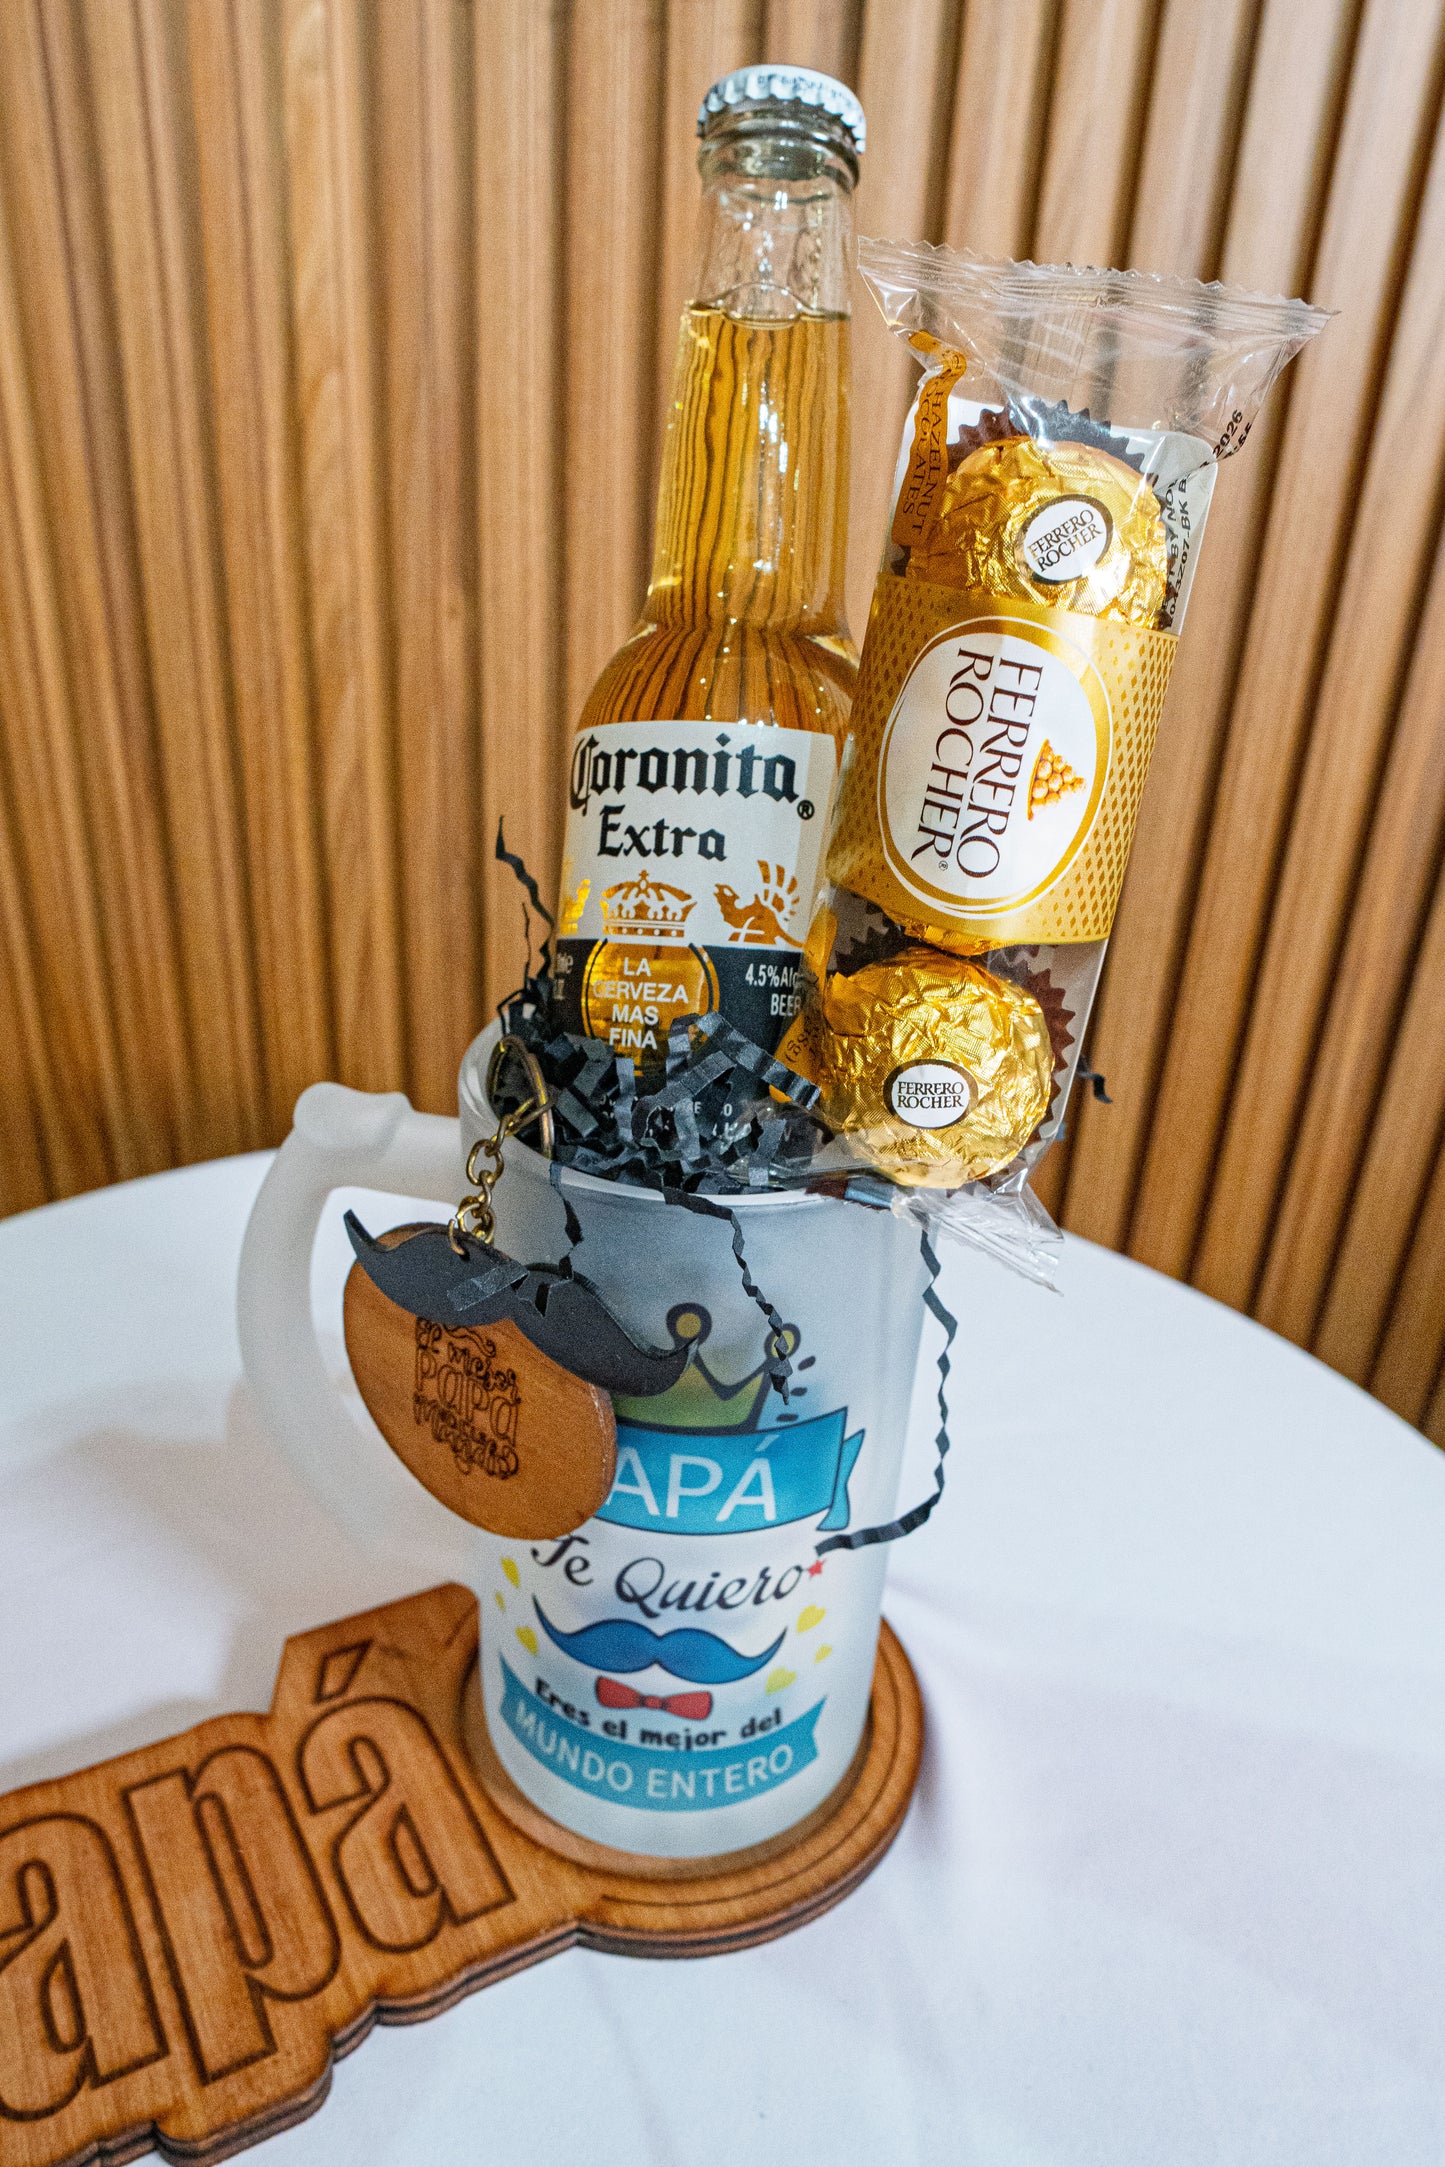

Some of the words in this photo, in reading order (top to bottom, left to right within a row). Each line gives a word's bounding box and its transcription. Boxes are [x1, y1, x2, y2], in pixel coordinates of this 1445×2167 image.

[911, 390, 945, 535] HAZELNUT
[1168, 527, 1179, 560] BY
[1213, 409, 1243, 459] 2026
[1027, 509, 1094, 559] FERRERO
[1036, 523, 1104, 572] ROCHER
[570, 733, 799, 816] Coronita
[911, 647, 995, 861] ROCHER
[956, 658, 1044, 879] FERRERO
[597, 804, 728, 861] Extra
[593, 980, 690, 1004] CERVEZA
[624, 956, 651, 977] LA
[609, 1027, 658, 1050] FINA
[612, 1003, 660, 1026] MAS
[897, 1095, 965, 1109] ROCHER
[898, 1081, 965, 1096] FERRERO
[604, 1434, 780, 1523] APÁ
[530, 1535, 594, 1586] Te
[614, 1557, 805, 1618] Quiero
[515, 1700, 634, 1792] MUNDO
[646, 1744, 794, 1799] ENTERO
[535, 1676, 591, 1727] Eres
[602, 1719, 628, 1740] el
[639, 1728, 727, 1752] mejor
[740, 1707, 782, 1739] del
[0, 1640, 517, 2122] apá
